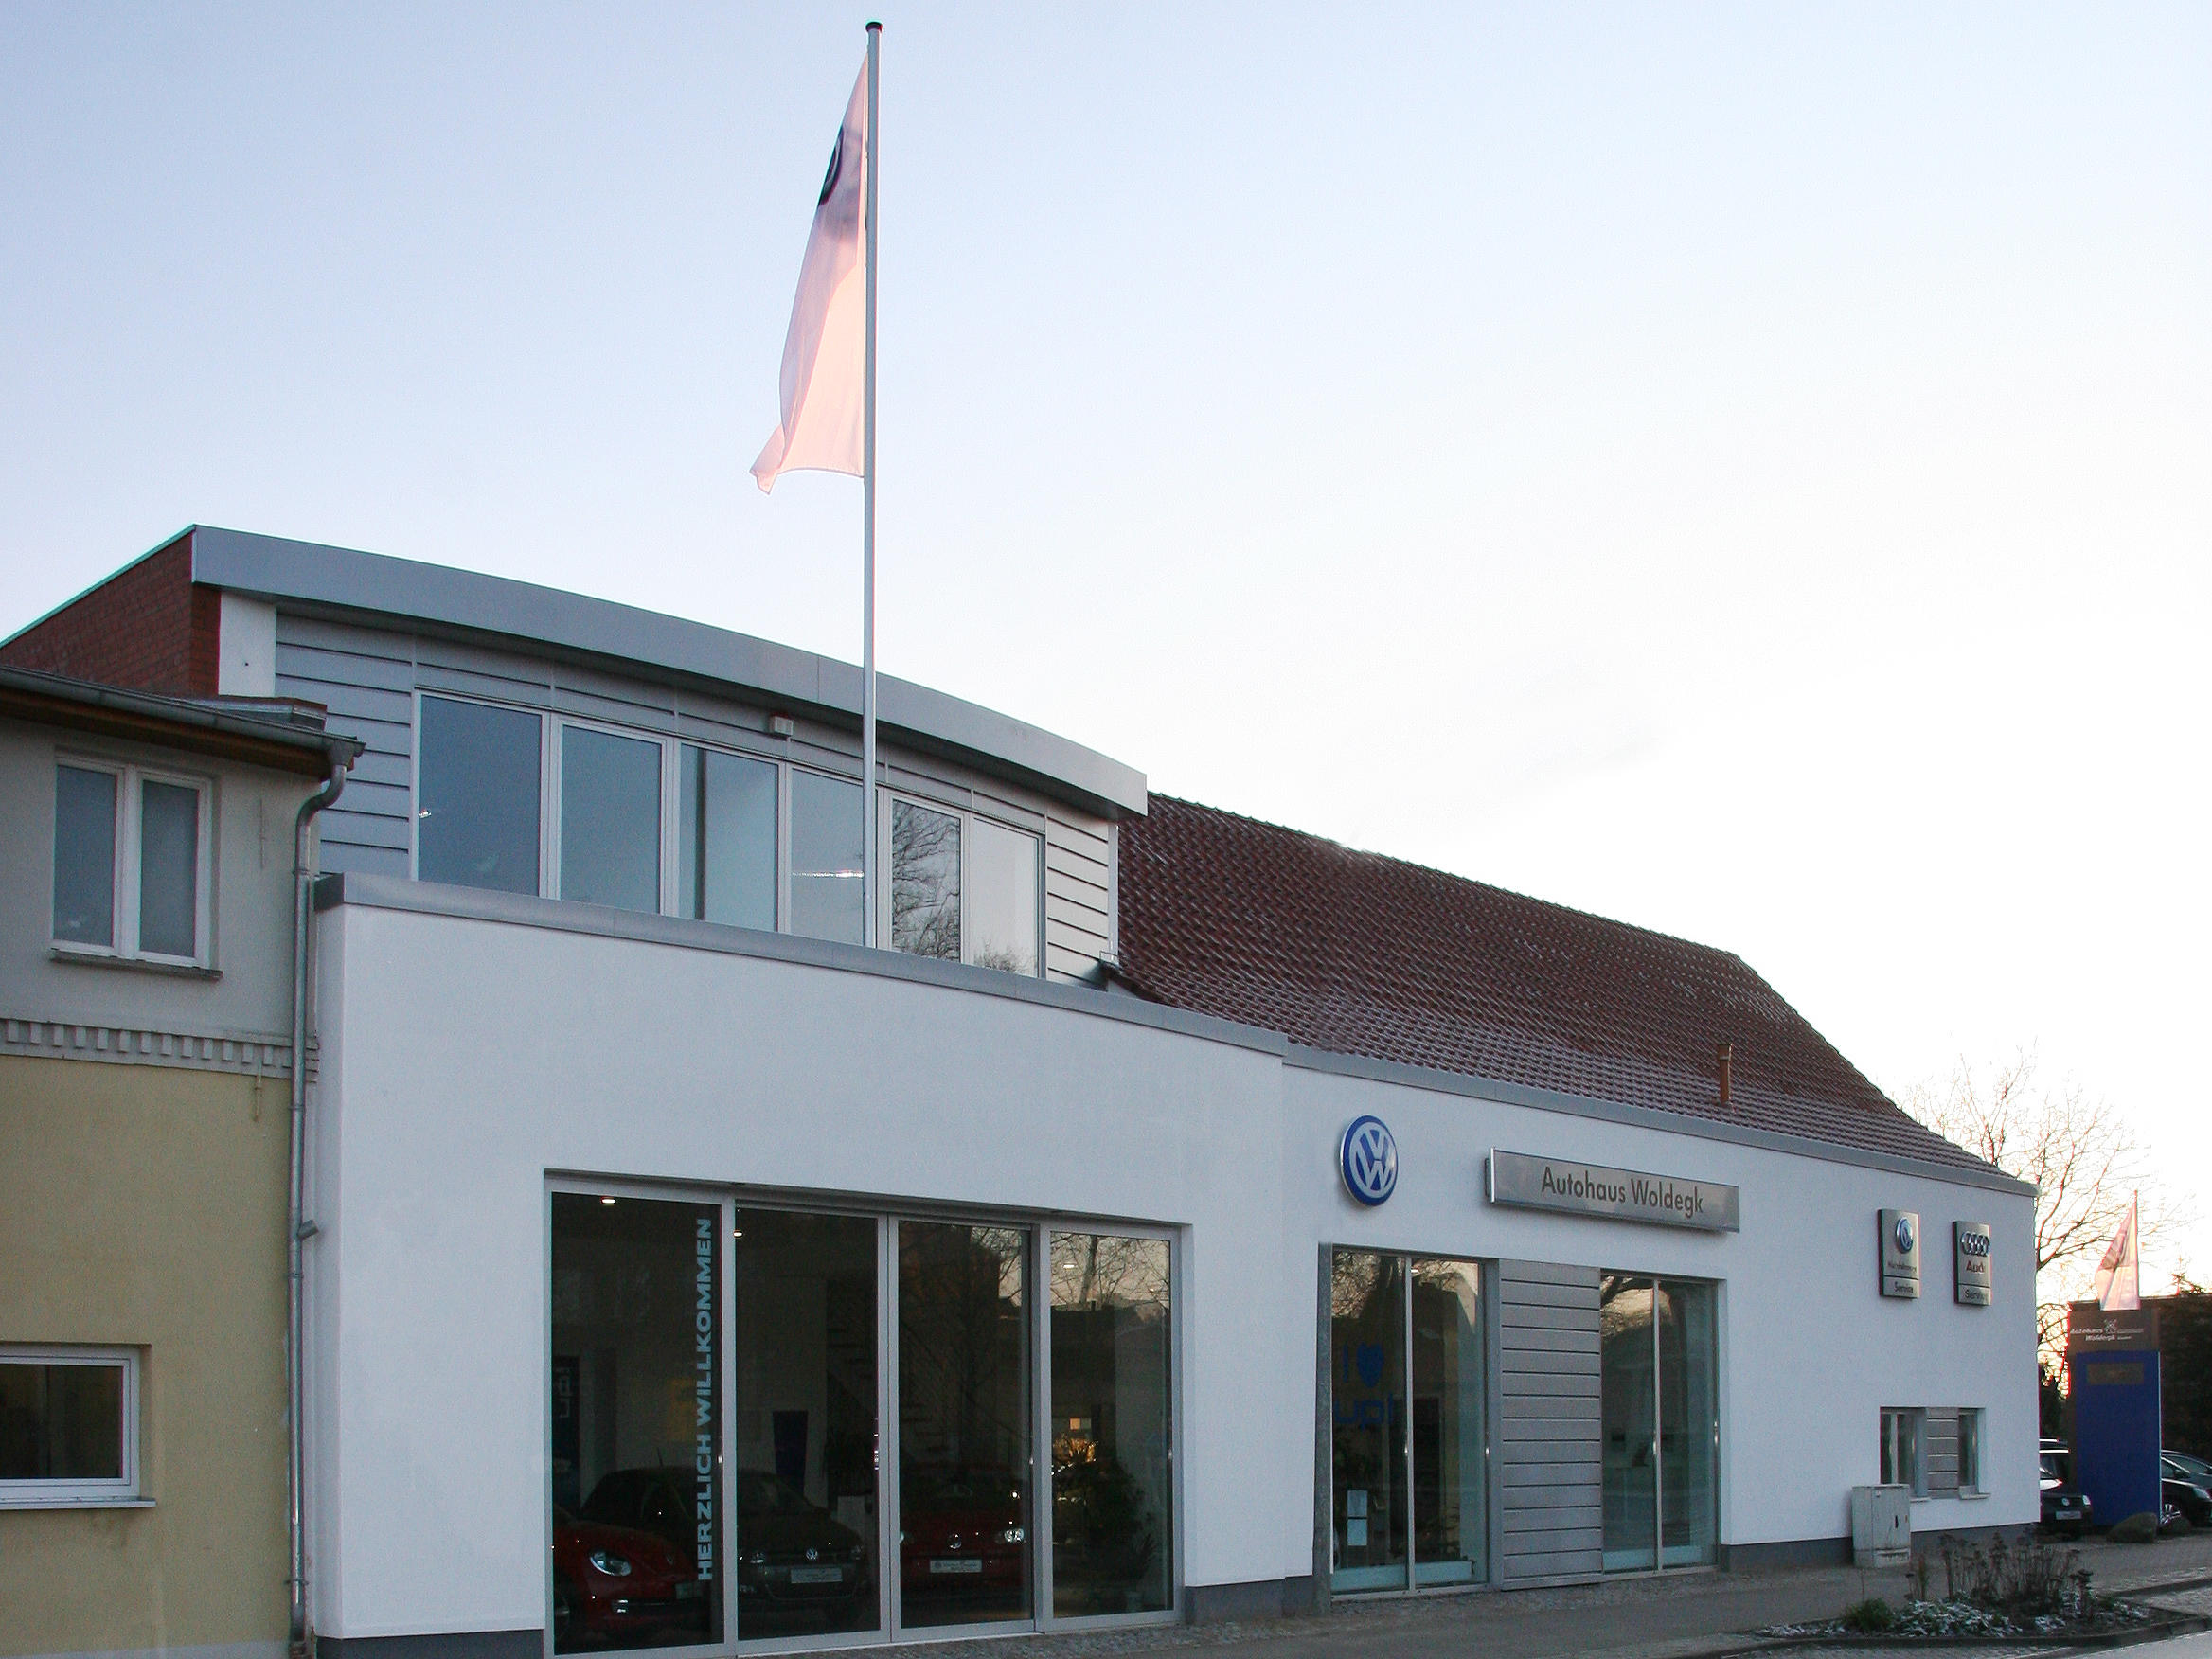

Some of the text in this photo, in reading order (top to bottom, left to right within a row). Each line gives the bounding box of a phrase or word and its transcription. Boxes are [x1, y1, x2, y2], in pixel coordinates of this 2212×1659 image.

[1348, 1121, 1397, 1199] VW
[1541, 1166, 1704, 1219] Autohaus Woldegk
[696, 1219, 713, 1580] HERZLICH WILLKOMMEN
